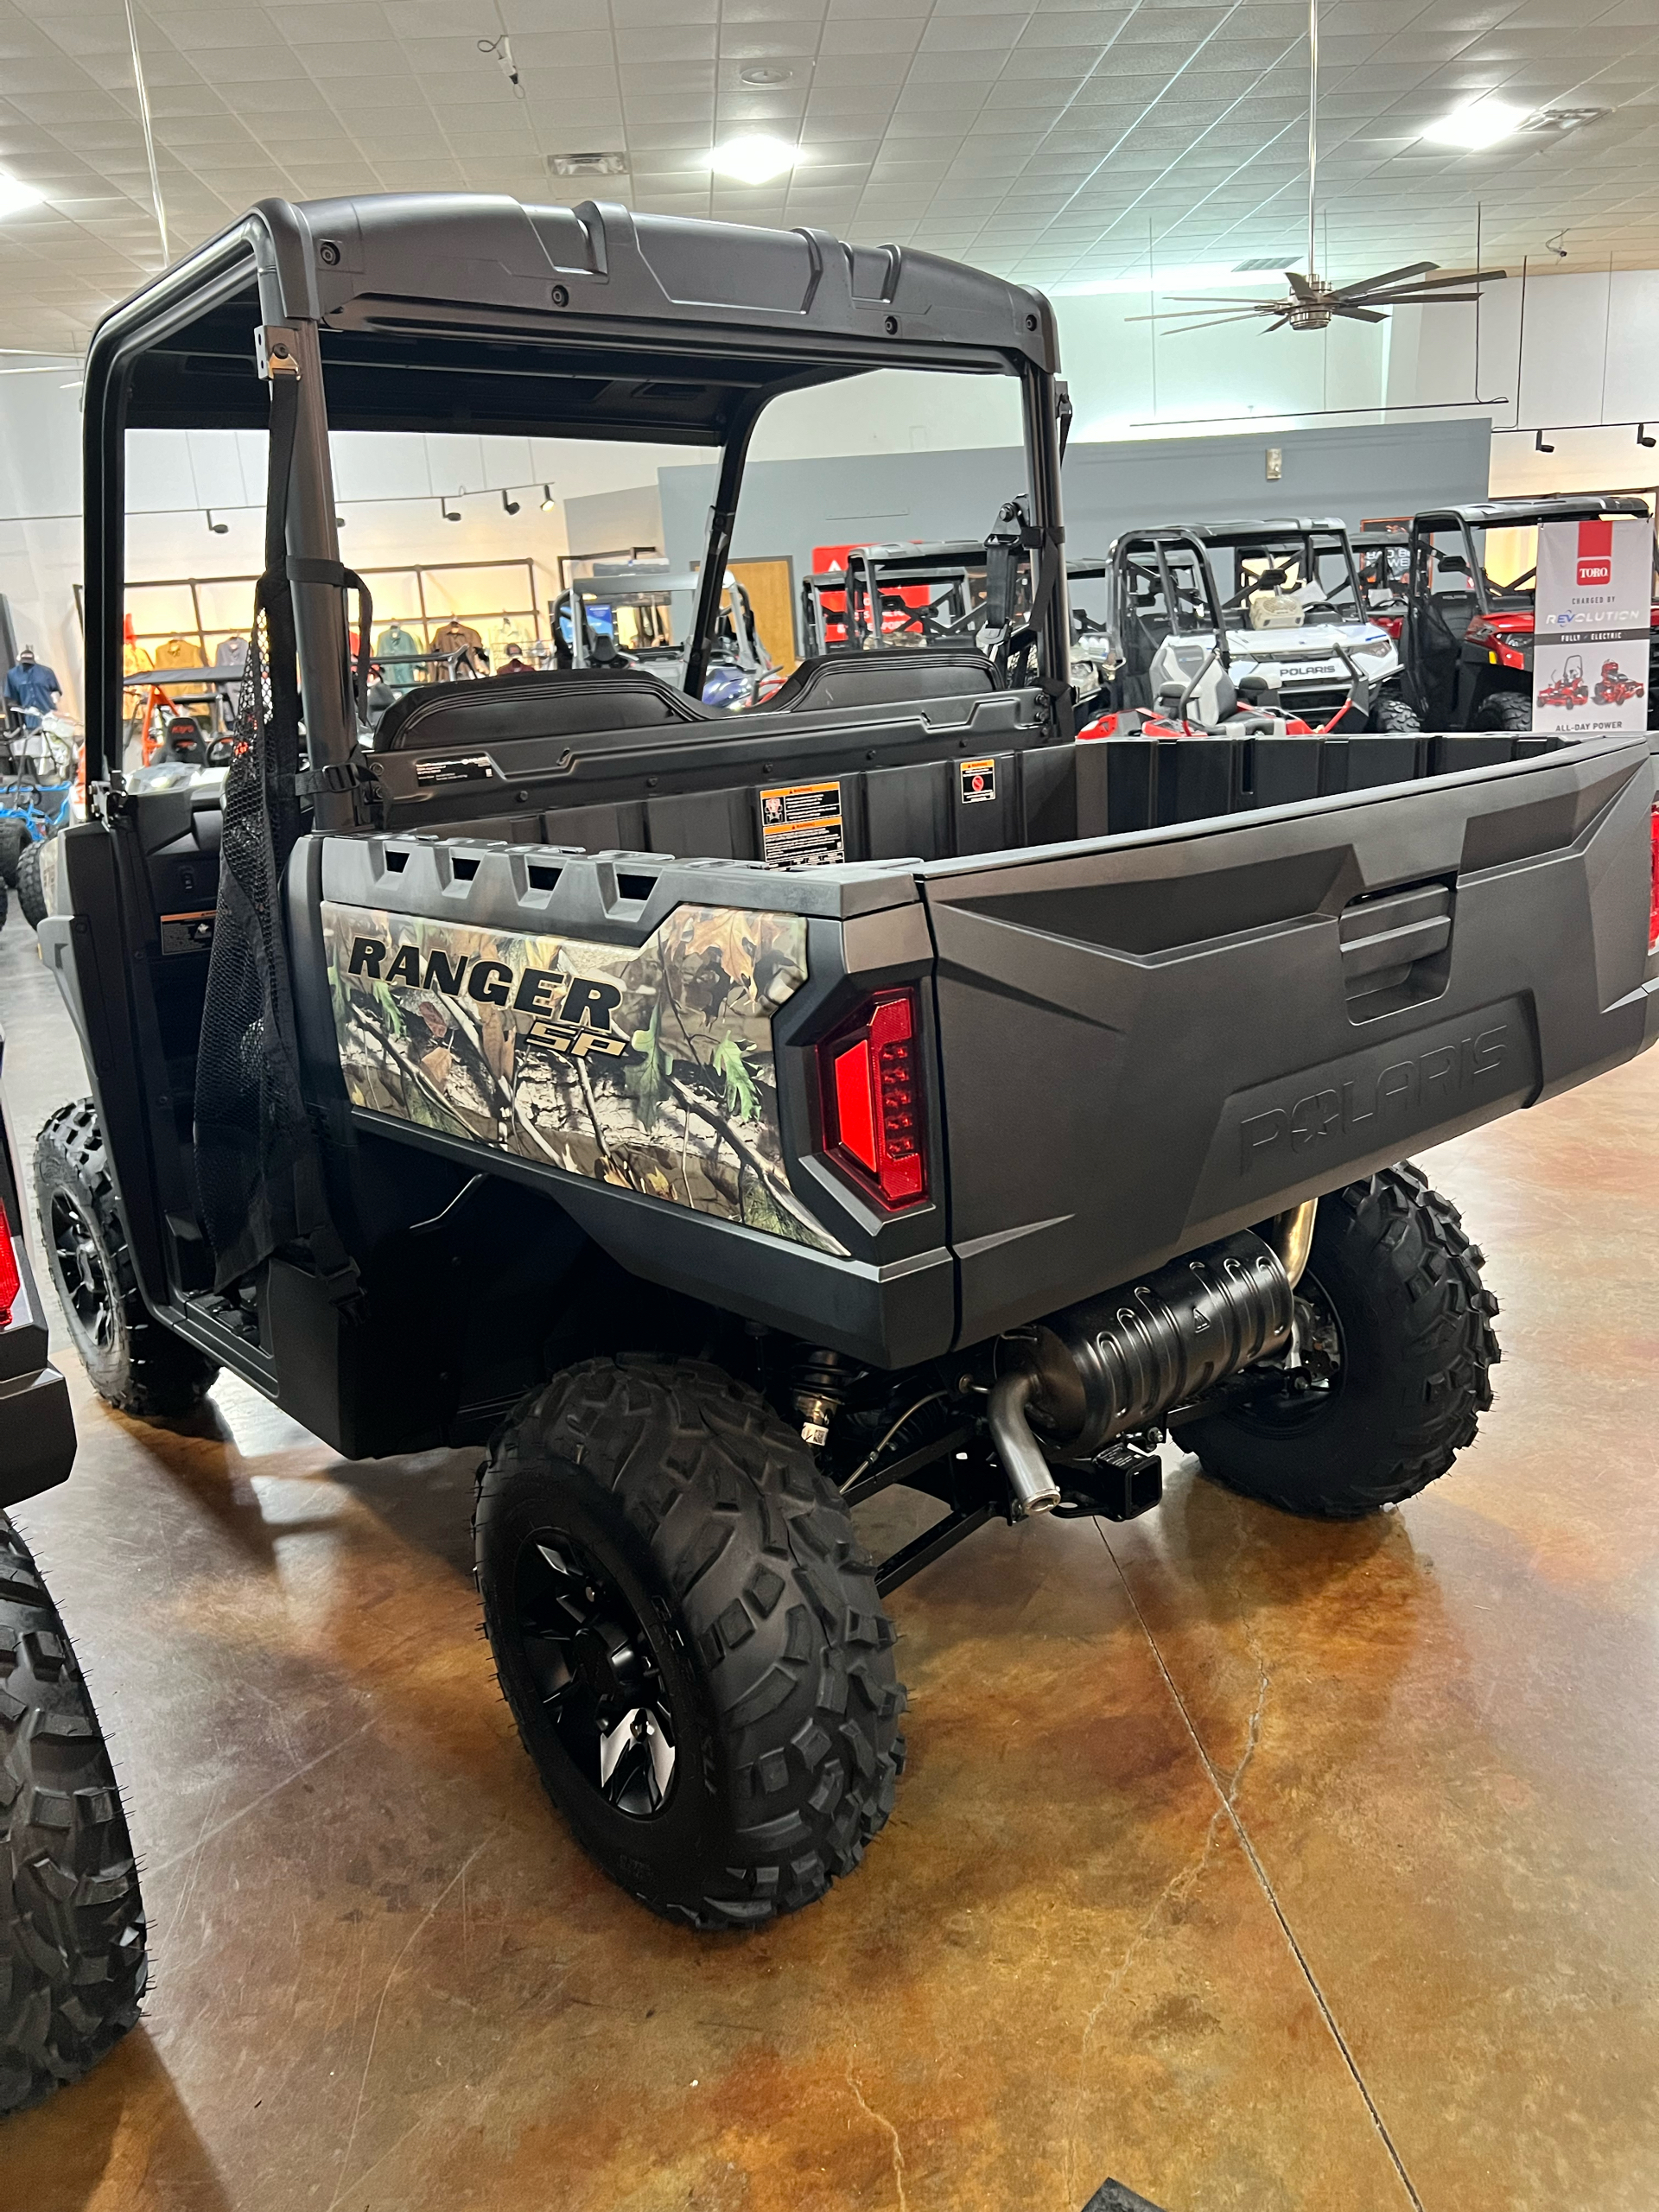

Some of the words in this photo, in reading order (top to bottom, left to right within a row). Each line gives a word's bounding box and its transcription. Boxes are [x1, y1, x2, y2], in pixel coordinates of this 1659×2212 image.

[1579, 567, 1609, 578] TORO
[1572, 596, 1604, 605] CHARGED
[1545, 609, 1640, 626] REVOLUTION
[1591, 632, 1622, 640] ELECTRIC
[1280, 665, 1336, 677] POLARIS
[1555, 723, 1591, 732] ALL-DAY
[1592, 721, 1623, 730] POWER
[347, 935, 623, 1034] RANGER
[524, 1020, 631, 1058] SP
[1240, 1025, 1507, 1175] POLARIS
